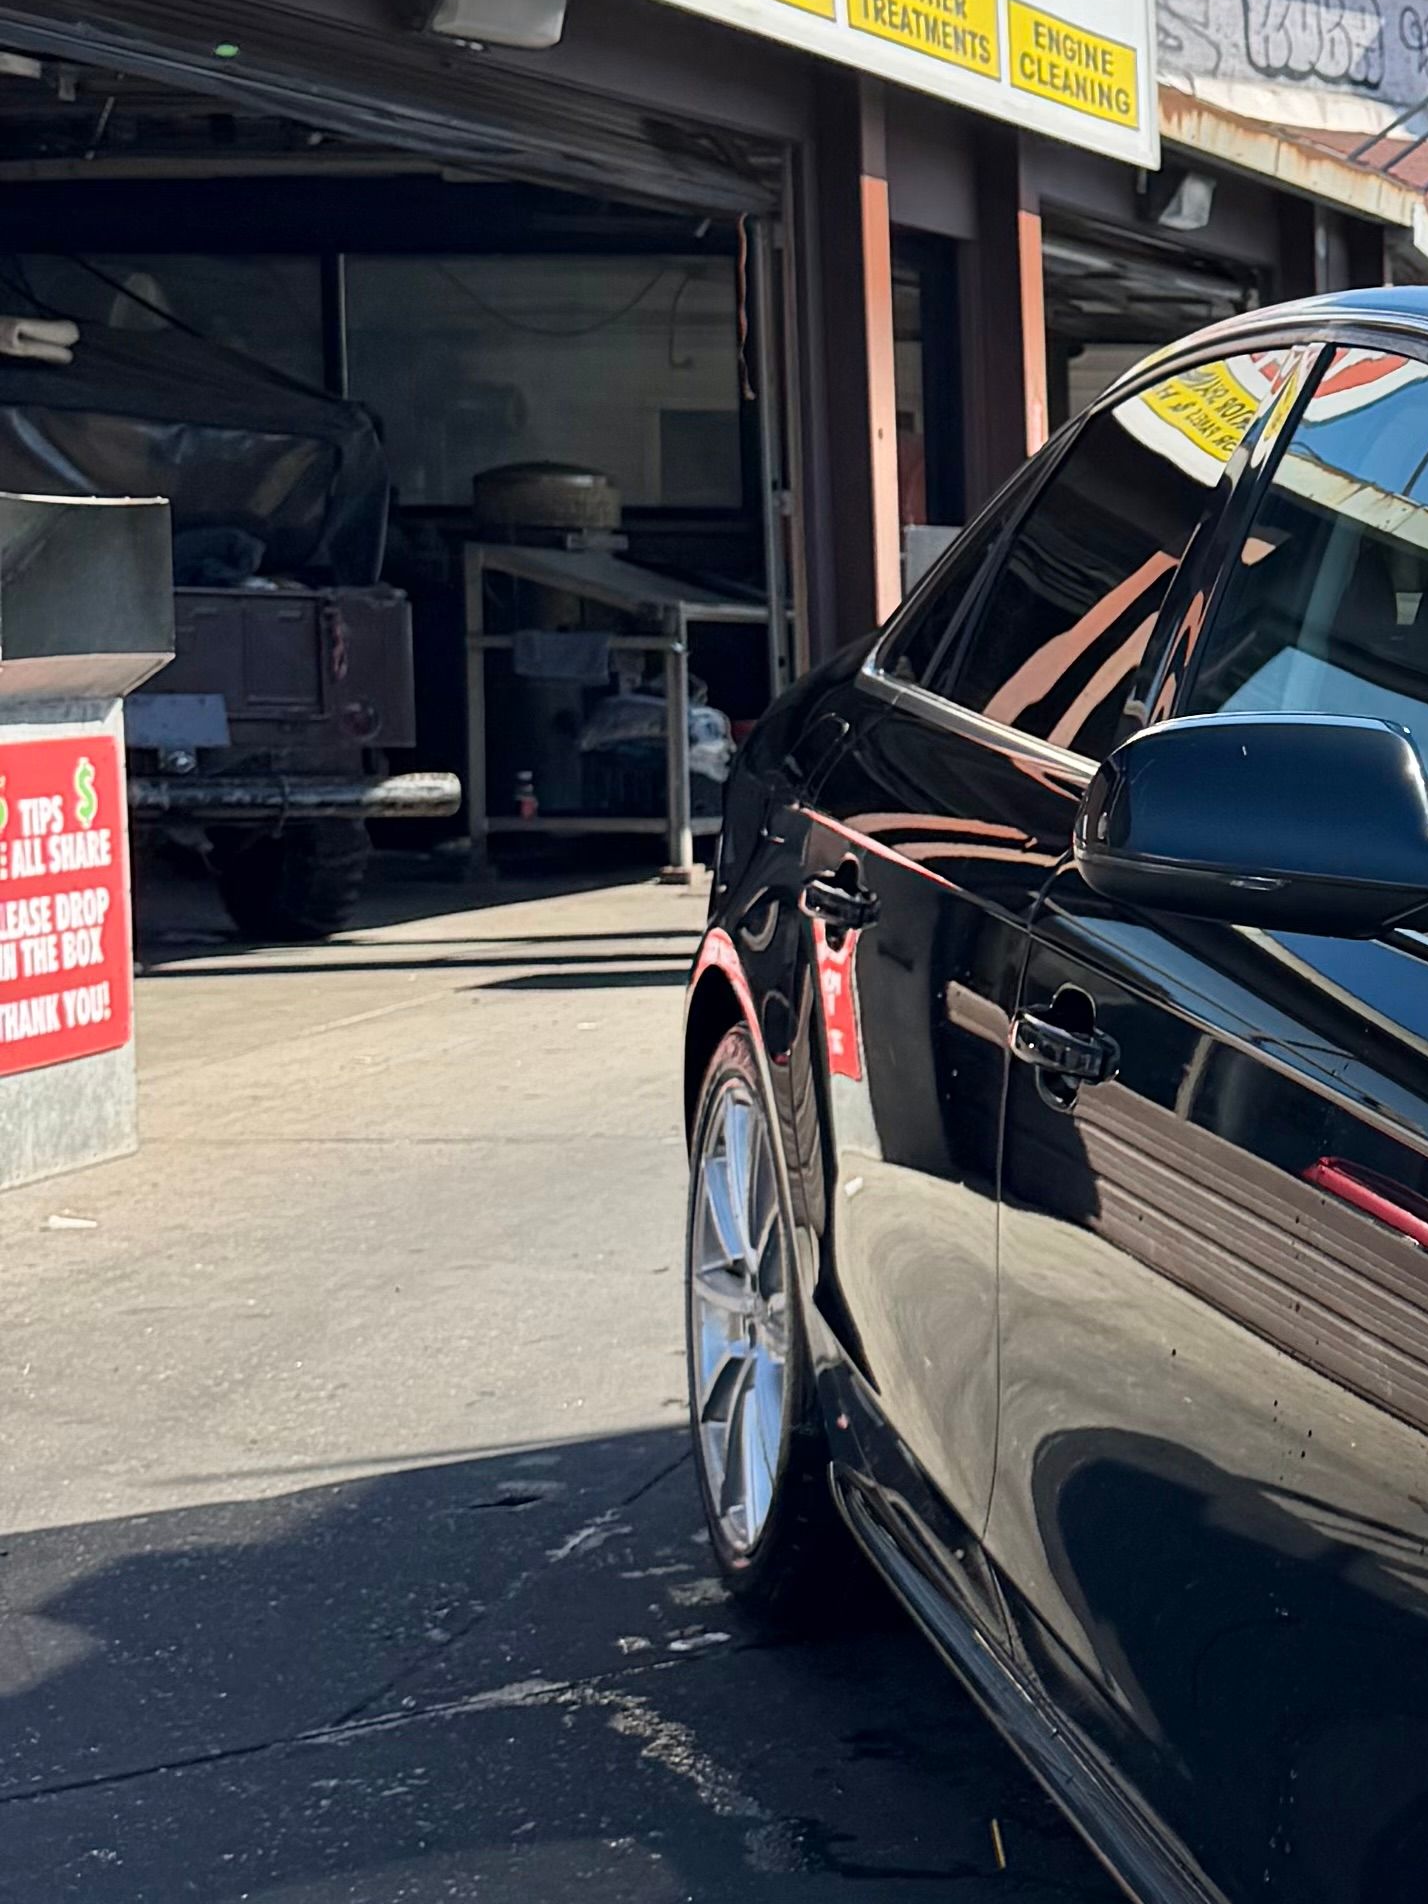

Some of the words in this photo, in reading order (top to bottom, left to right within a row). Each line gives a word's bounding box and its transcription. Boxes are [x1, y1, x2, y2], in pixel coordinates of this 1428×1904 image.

[1033, 21, 1114, 77] ENGINE
[1020, 52, 1130, 115] CLEANING
[18, 795, 65, 837] TIPS
[11, 838, 46, 880] ALL
[48, 828, 112, 875] SHARE
[55, 887, 111, 933] DROP
[20, 934, 59, 978] THE
[61, 926, 104, 972] BOX
[0, 993, 63, 1043] THANK
[62, 980, 113, 1032] YOU!
